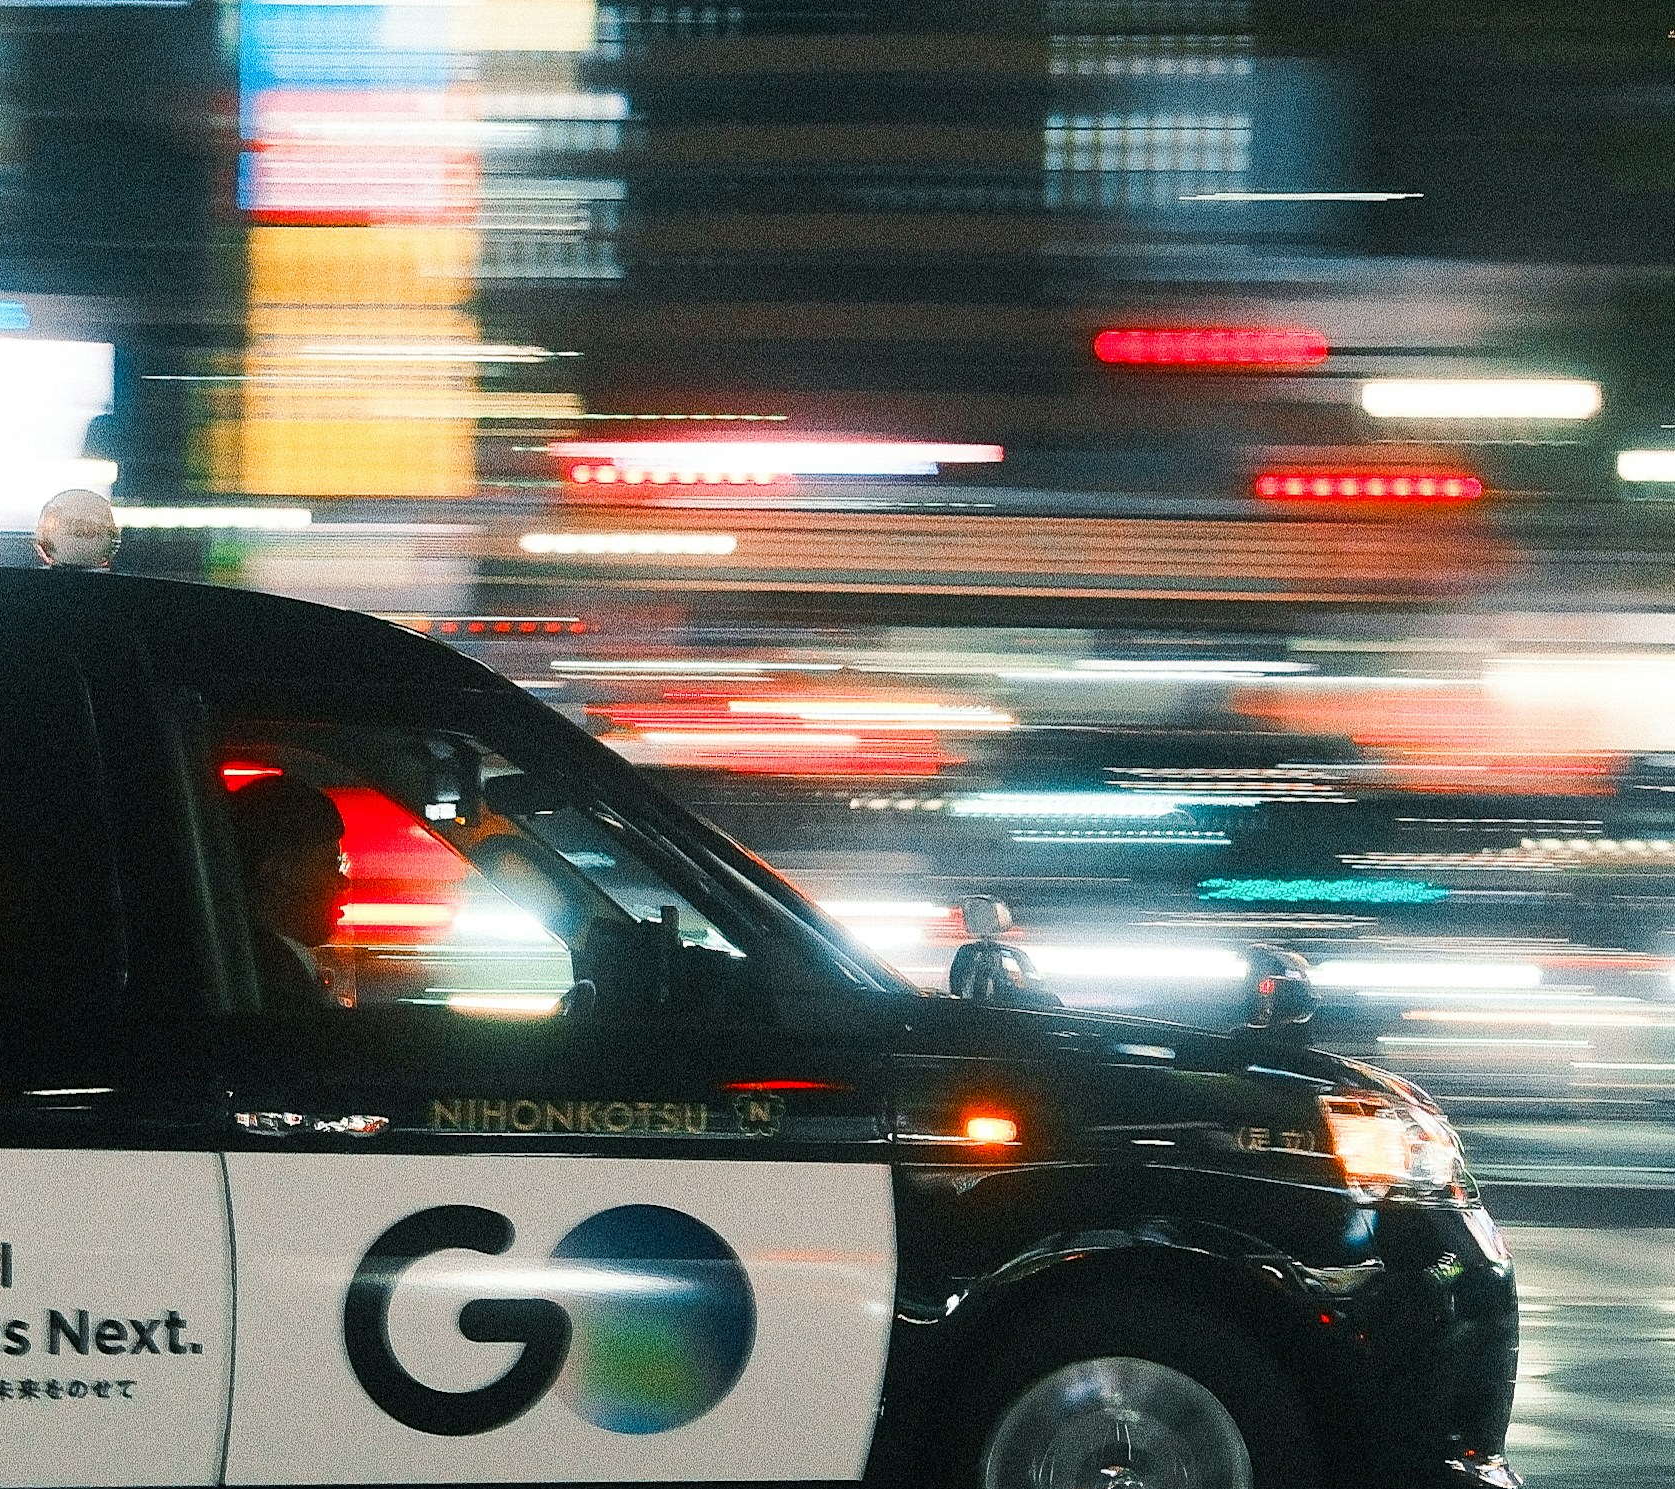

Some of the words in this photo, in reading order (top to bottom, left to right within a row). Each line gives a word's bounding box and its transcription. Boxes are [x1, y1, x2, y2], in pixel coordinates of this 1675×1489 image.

[433, 1098, 707, 1134] NIHONKOTSU
[46, 1309, 204, 1356] Next.
[343, 1203, 758, 1437] GO
